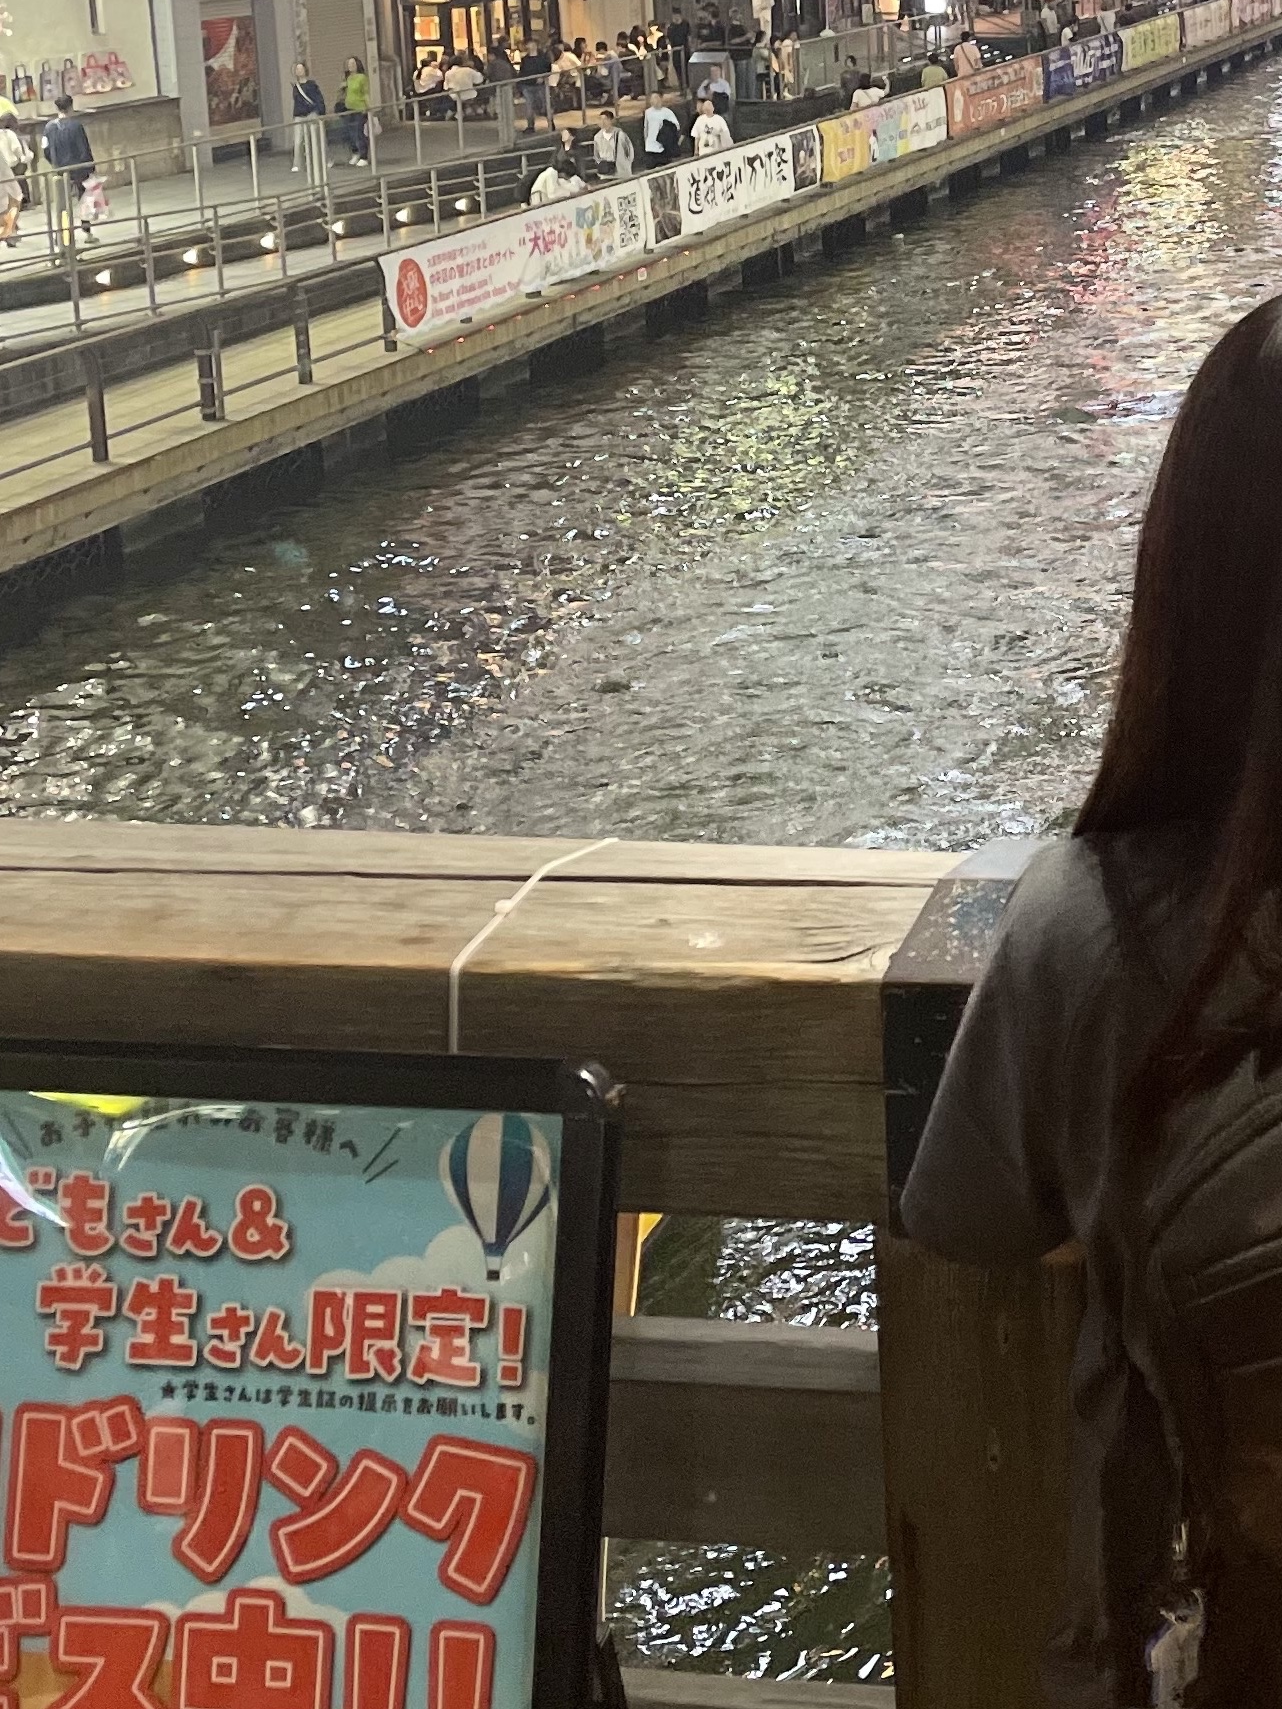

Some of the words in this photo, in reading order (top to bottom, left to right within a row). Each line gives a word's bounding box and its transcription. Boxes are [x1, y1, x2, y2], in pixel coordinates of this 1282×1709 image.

[36, 1265, 529, 1389] 学生さん限定!
